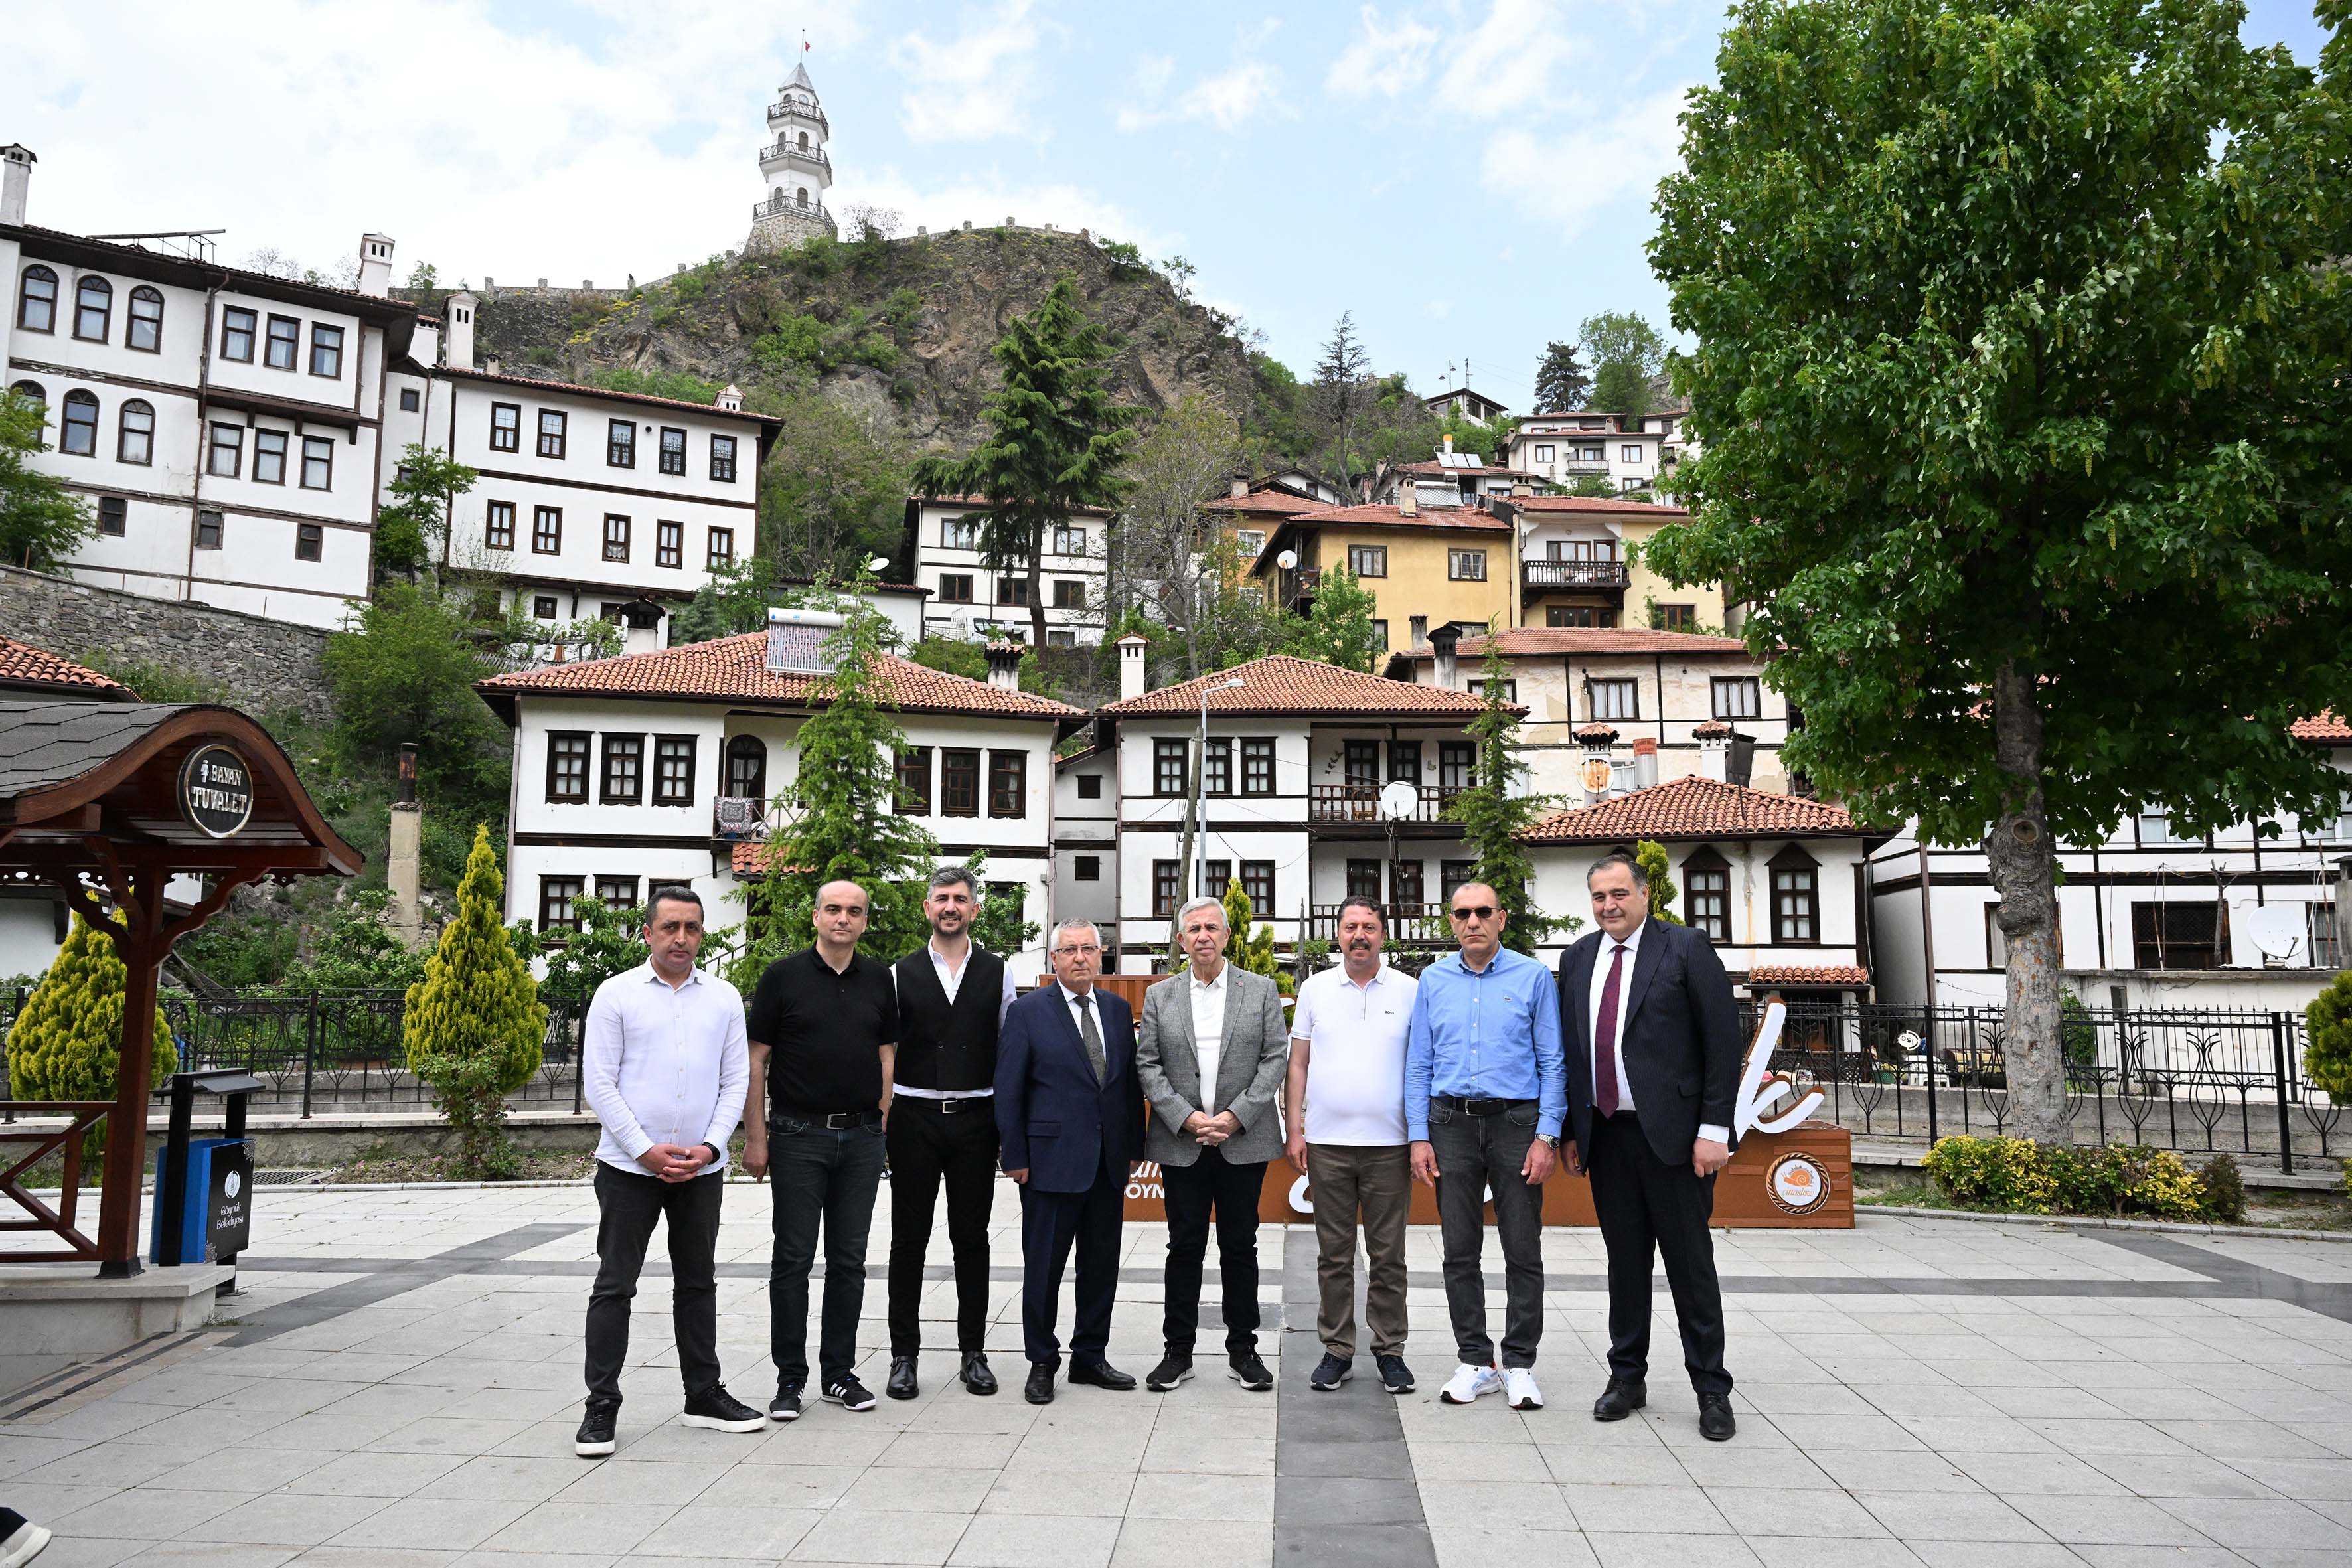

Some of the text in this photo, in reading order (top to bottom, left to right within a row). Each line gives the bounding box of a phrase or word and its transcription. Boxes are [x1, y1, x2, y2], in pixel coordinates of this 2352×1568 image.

[211, 765, 242, 786] BAYAN
[191, 786, 247, 814] TUVALET
[1124, 1179, 1165, 1199] ÖYN
[220, 1202, 241, 1217] Göynük
[216, 1214, 244, 1230] Belediyesi
